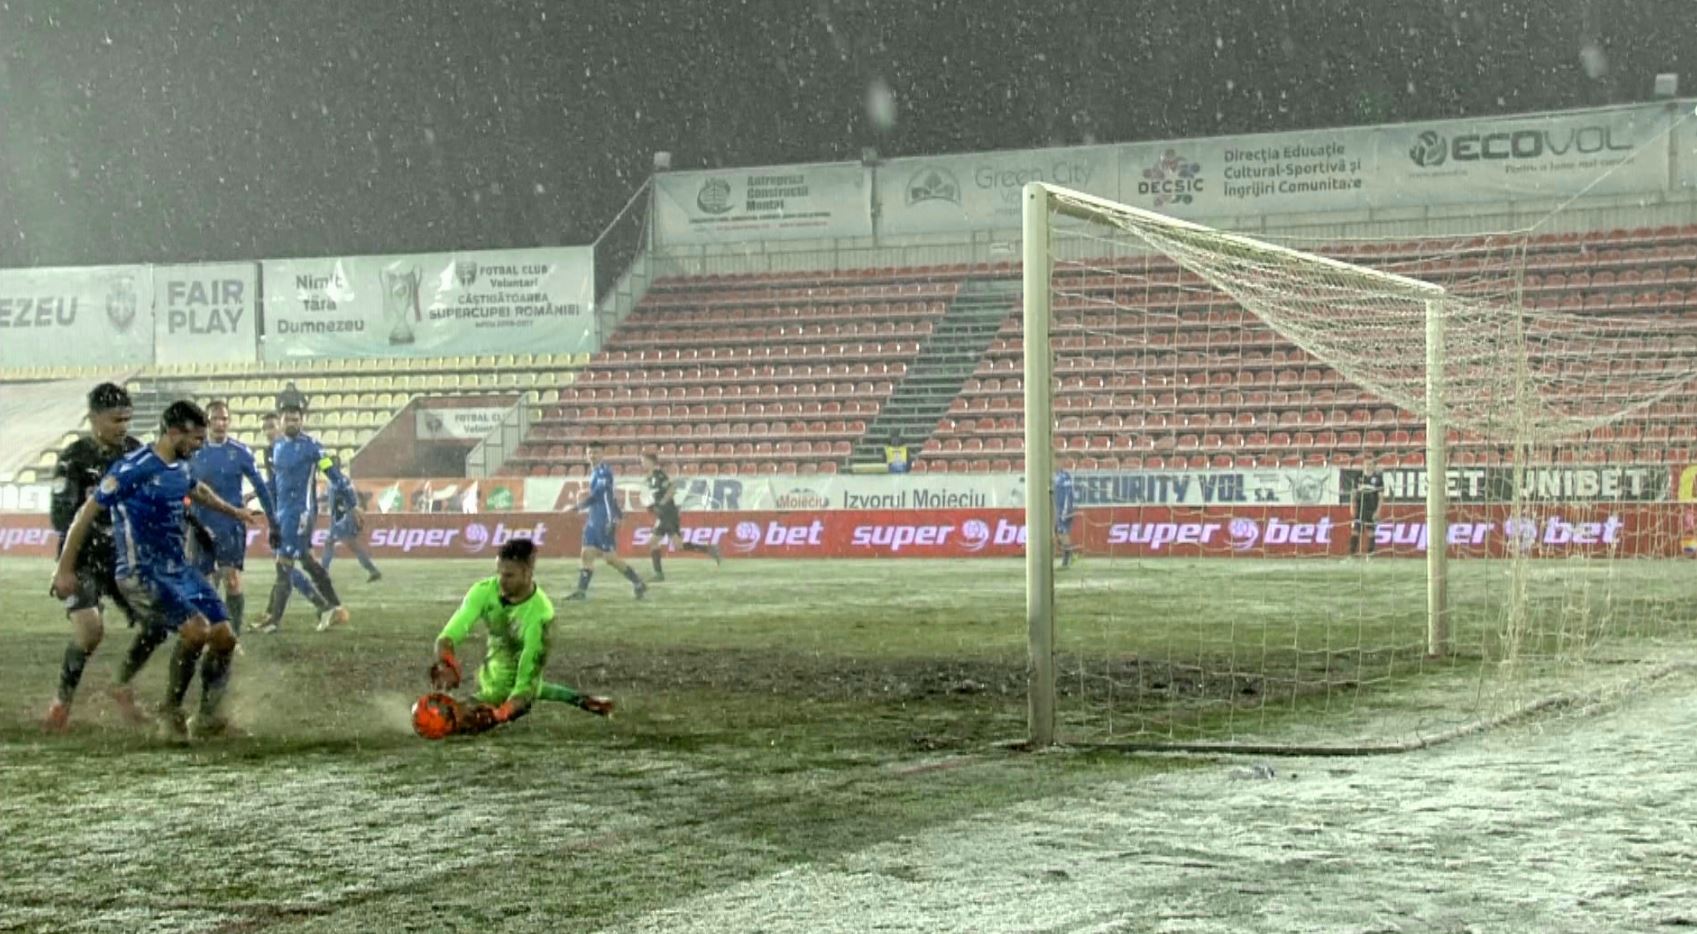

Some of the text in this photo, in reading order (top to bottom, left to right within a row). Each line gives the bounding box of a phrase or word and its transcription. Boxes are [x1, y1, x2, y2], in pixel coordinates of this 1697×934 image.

[1451, 126, 1634, 161] ECOVOL
[975, 160, 1093, 189] Green City
[1138, 178, 1204, 195] DECSIC
[1278, 177, 1362, 194] Comunitare
[480, 264, 548, 276] FOTBAL CLUB
[167, 280, 245, 306] FAIR
[490, 278, 538, 288] Voluntari
[167, 307, 245, 334] PLAY
[429, 305, 510, 320] SUPERCUPEI
[277, 319, 365, 334] Dumnezeu
[1073, 474, 1247, 503] SECURITY VOL
[1382, 470, 1485, 497] NIET
[843, 489, 985, 509] Izvorul Moieciu
[369, 529, 460, 551] super
[766, 520, 824, 545] bet
[853, 525, 955, 551] super
[1107, 517, 1334, 549] super bet
[1543, 515, 1624, 544] bet
